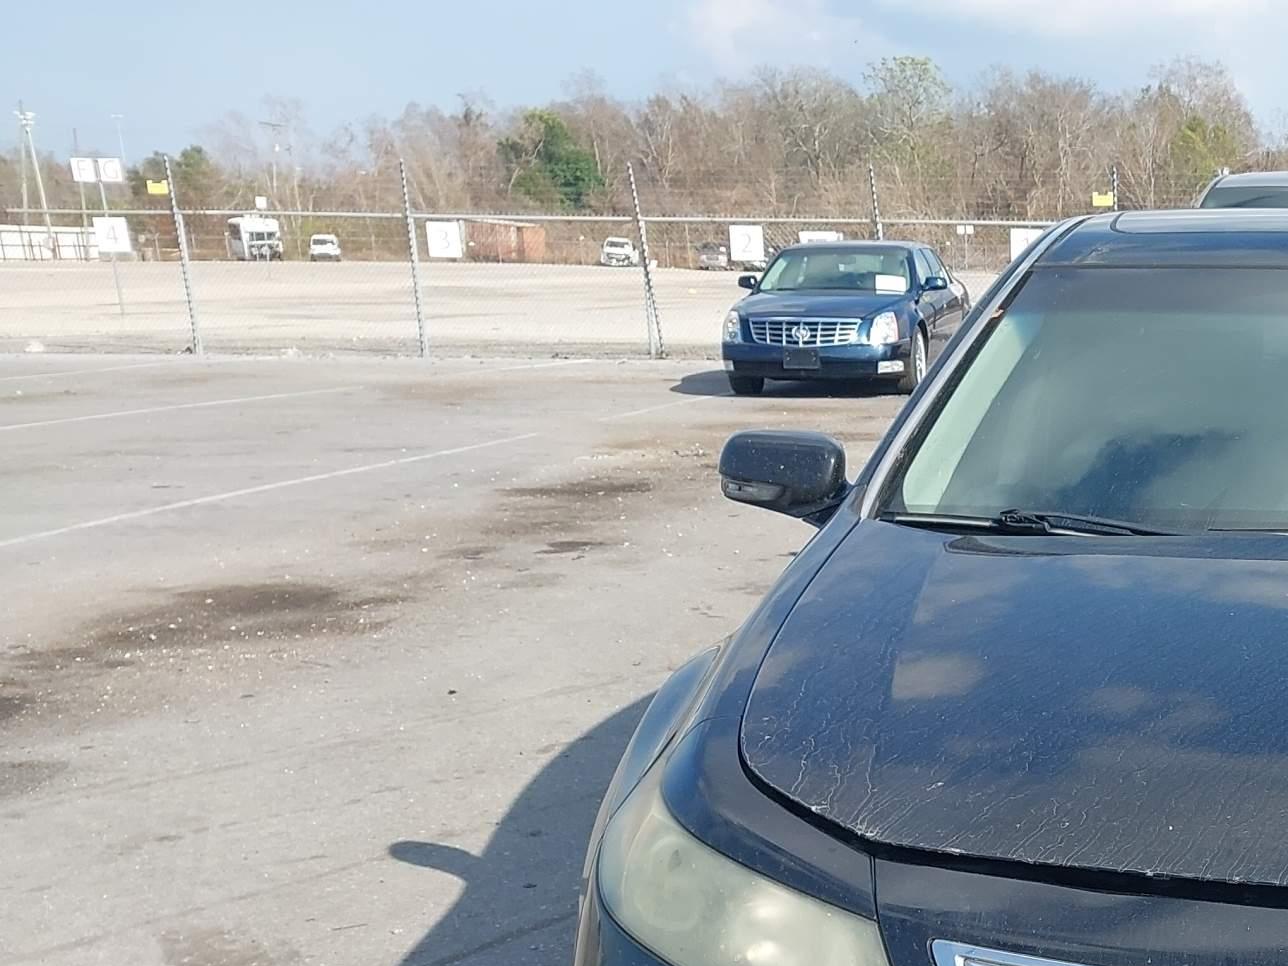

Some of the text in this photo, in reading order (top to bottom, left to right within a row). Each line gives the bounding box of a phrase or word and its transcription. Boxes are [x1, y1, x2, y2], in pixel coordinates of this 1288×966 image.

[76, 159, 88, 179] F
[103, 159, 120, 180] G
[106, 224, 119, 245] 4
[740, 232, 753, 254] 2
